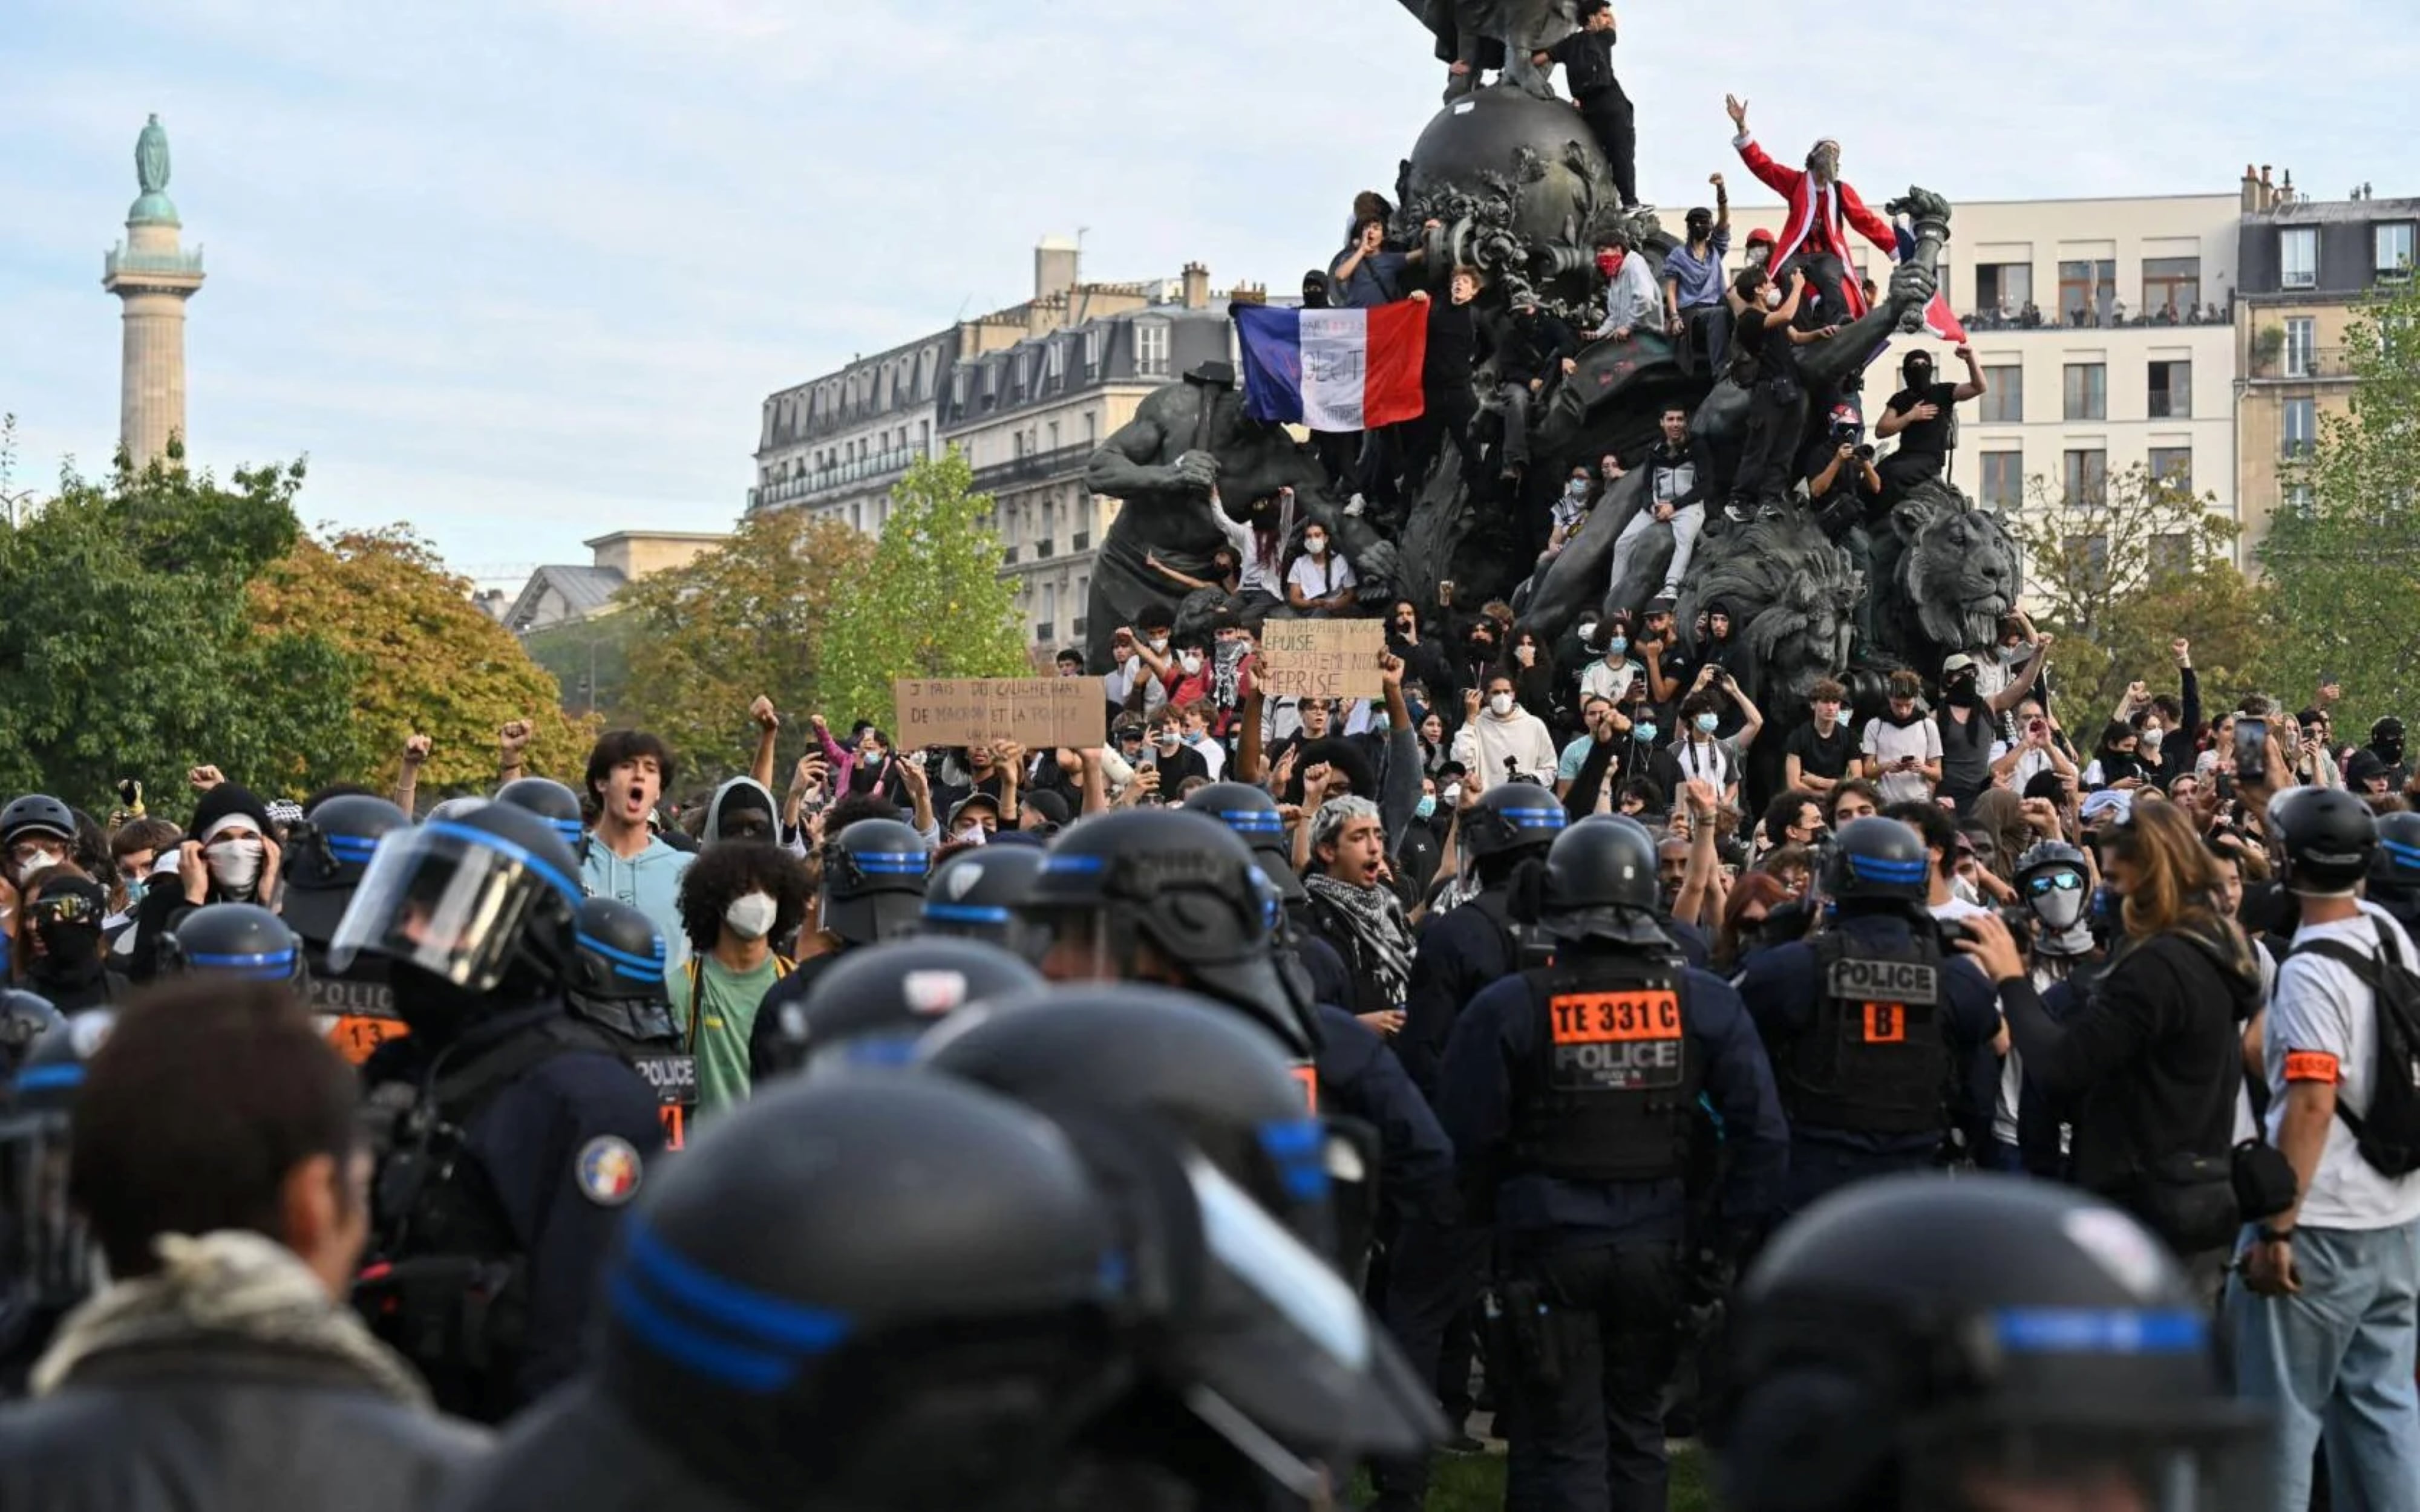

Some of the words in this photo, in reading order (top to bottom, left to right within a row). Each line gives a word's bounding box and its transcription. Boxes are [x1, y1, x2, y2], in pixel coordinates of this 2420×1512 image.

[911, 706, 929, 724] DE
[992, 708, 1007, 723] ET
[1012, 707, 1025, 723] LA
[1834, 961, 1932, 991] POLICE
[306, 981, 393, 1008] POLIC
[1555, 1005, 1588, 1033] TE
[1597, 1001, 1650, 1031] 331
[1659, 999, 1675, 1028] C
[1555, 1041, 1677, 1070] POLICE
